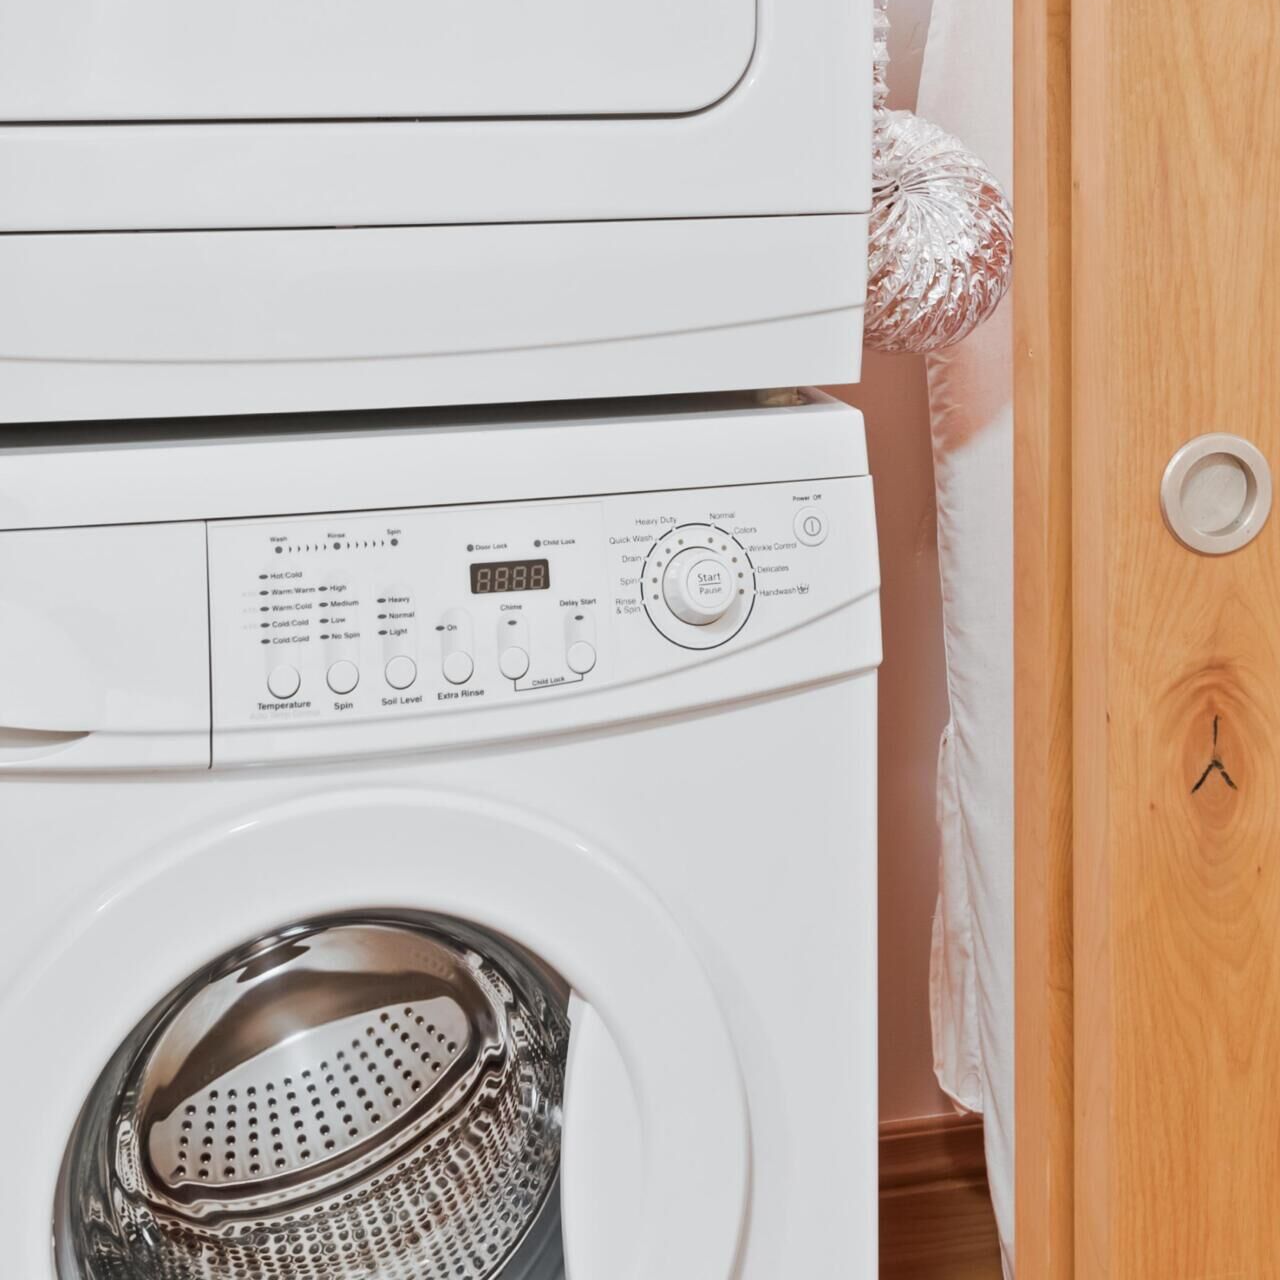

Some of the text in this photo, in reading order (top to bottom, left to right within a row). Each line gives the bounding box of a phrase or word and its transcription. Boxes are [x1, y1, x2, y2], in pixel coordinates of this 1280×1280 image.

[792, 494, 810, 502] Power
[635, 515, 677, 526] Heavy Duty
[709, 511, 735, 520] Normal
[386, 527, 402, 536] Spin
[734, 525, 757, 535] Colors
[270, 535, 288, 543] Wash
[543, 538, 560, 547] Child
[609, 533, 653, 546] Quick Wash
[475, 542, 508, 551] Door Lock
[748, 541, 797, 553] Wrinkle Control
[621, 554, 642, 564] Drain
[757, 564, 790, 573] Delicates
[619, 576, 638, 587] Spin
[697, 572, 721, 584] Start
[329, 584, 347, 593] High
[699, 586, 722, 596] Pause
[759, 586, 797, 597] Handwash
[330, 599, 359, 608] Medium
[387, 595, 410, 605] Heavy
[559, 597, 597, 608] Delay Start
[615, 597, 637, 606] Rinse
[500, 603, 523, 612] Chime
[623, 605, 641, 616] Spin
[389, 610, 415, 620] Normal
[389, 627, 408, 637] Light
[446, 624, 458, 632] On
[331, 631, 361, 641] No Spin
[531, 675, 566, 687] Child Lock
[437, 687, 485, 701] Extra Rinse
[257, 699, 312, 712] Temperature
[381, 694, 423, 707] Soil Level
[333, 701, 354, 712] Spin
